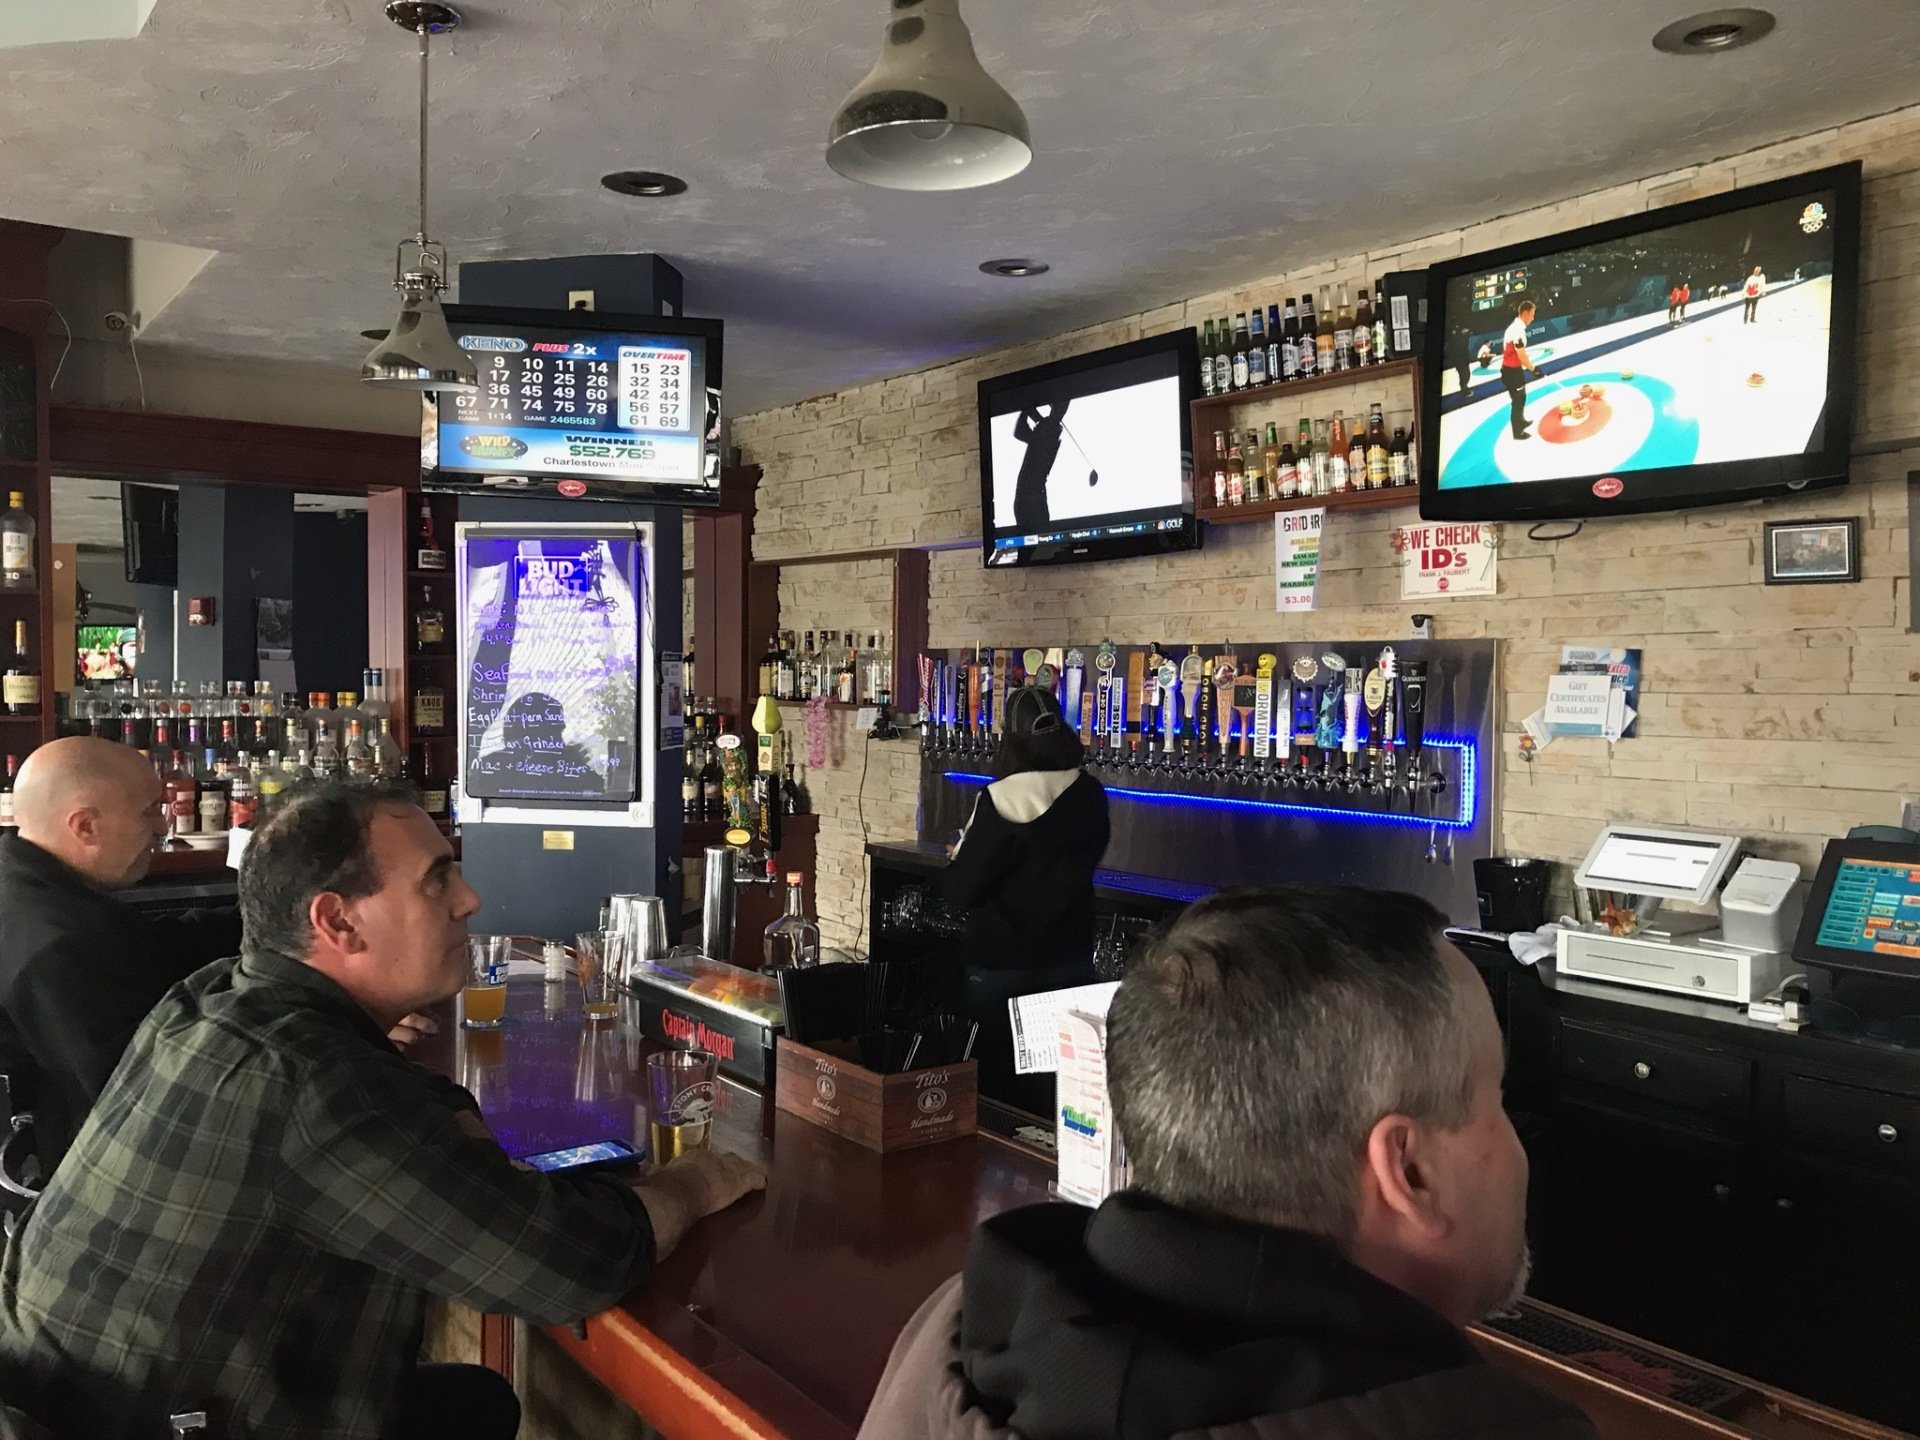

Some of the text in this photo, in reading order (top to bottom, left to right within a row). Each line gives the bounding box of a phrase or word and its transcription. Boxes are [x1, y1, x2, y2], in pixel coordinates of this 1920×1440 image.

[463, 336, 522, 352] KENO
[533, 342, 597, 355] PLUS 2x
[622, 351, 687, 361] OVERTIME
[494, 356, 609, 374] 9 10 11 14
[631, 363, 680, 376] 15 23
[489, 370, 609, 387] 17 20 25 26
[629, 377, 680, 389] 32 34
[488, 383, 608, 401] 36 45 49 60
[629, 389, 680, 402] 42 44
[455, 396, 608, 415] 67 71 74 75 78
[629, 402, 680, 415] 56 57
[487, 412, 512, 421] 1:14
[550, 416, 596, 426] 2465583
[629, 415, 680, 428] 61 69
[565, 435, 654, 447] WINNER
[543, 456, 616, 469] Charlestown
[1166, 517, 1183, 529] GOLF
[1283, 515, 1308, 532] GRID
[1410, 524, 1480, 549] WE CHECK
[1281, 560, 1298, 568] NEW
[1421, 547, 1468, 570] ID's
[527, 560, 574, 579] BUD
[519, 578, 584, 597] LIGHT
[1285, 595, 1311, 604] $3.00
[919, 656, 930, 711] Budweiser
[1568, 682, 1588, 691] GIFT
[1201, 678, 1209, 710] HOBO
[1550, 693, 1607, 703] CERTIFICATES
[1554, 704, 1599, 715] AVAILABLE
[1112, 704, 1120, 733] RISE
[471, 758, 500, 771] Mac
[662, 1008, 735, 1061] Captain Morgan
[815, 1058, 838, 1077] Tito's
[915, 1069, 950, 1089] Tito's
[674, 1087, 698, 1109] STONY
[812, 1097, 840, 1116] Handmade
[910, 1110, 954, 1130] Handmade
